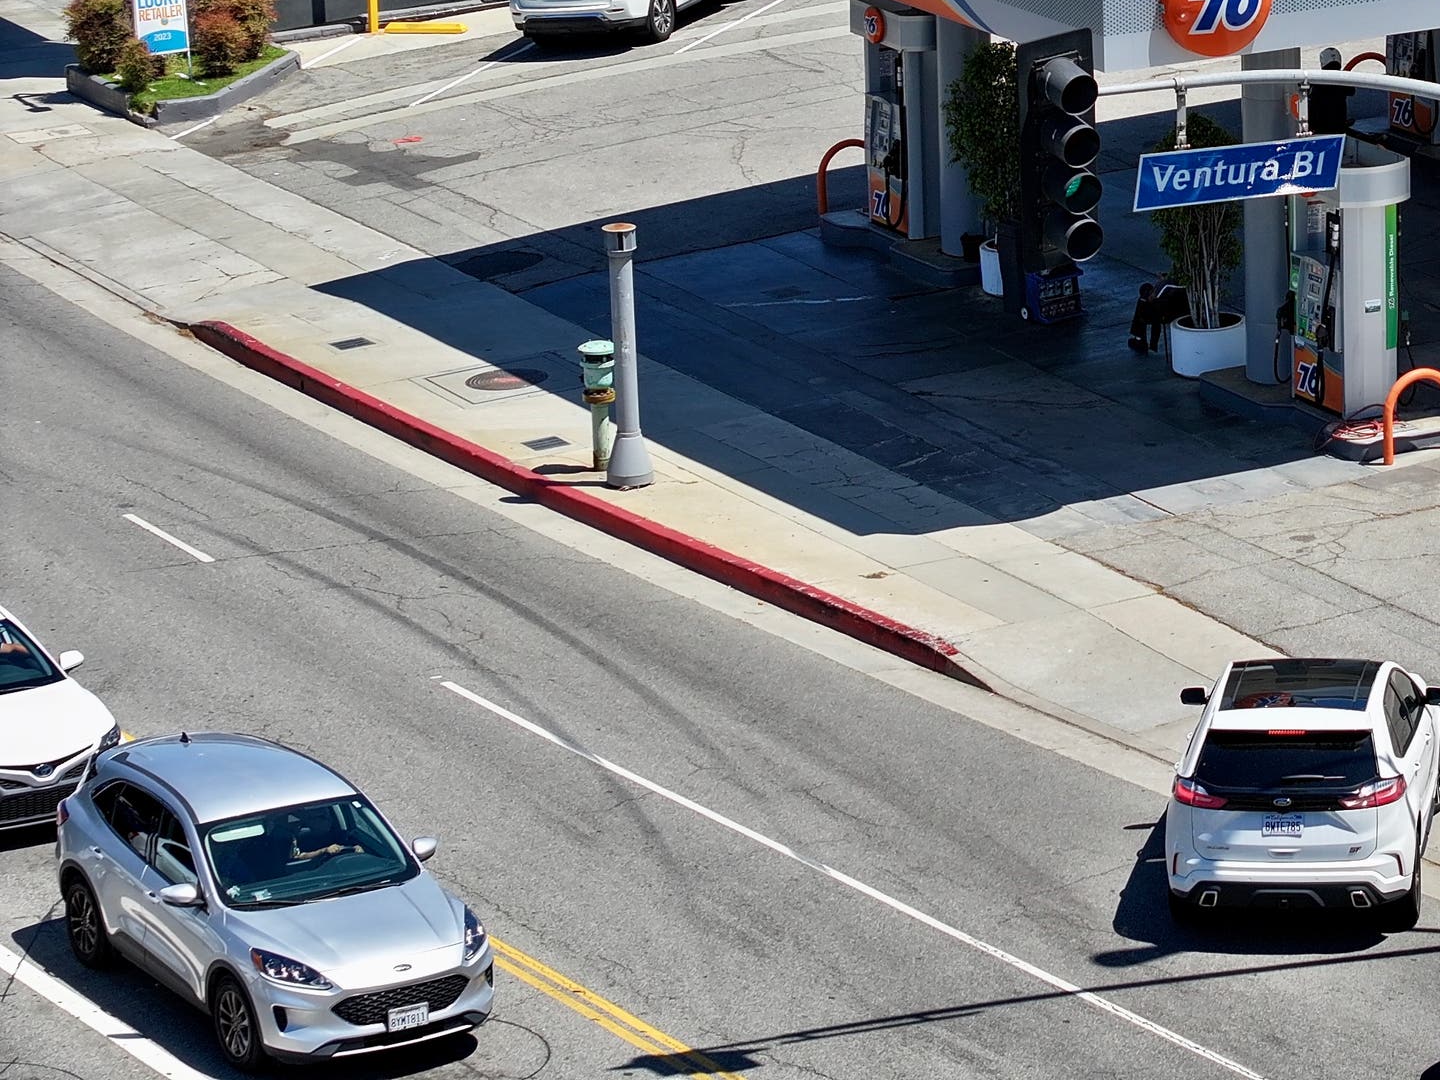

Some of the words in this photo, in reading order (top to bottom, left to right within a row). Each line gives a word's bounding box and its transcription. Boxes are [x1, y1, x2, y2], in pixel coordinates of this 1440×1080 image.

[139, 5, 182, 22] RETAILER
[154, 32, 172, 41] 2023
[1392, 98, 1413, 128] 76
[1153, 158, 1280, 193] Ventura
[1293, 151, 1324, 177] Bl
